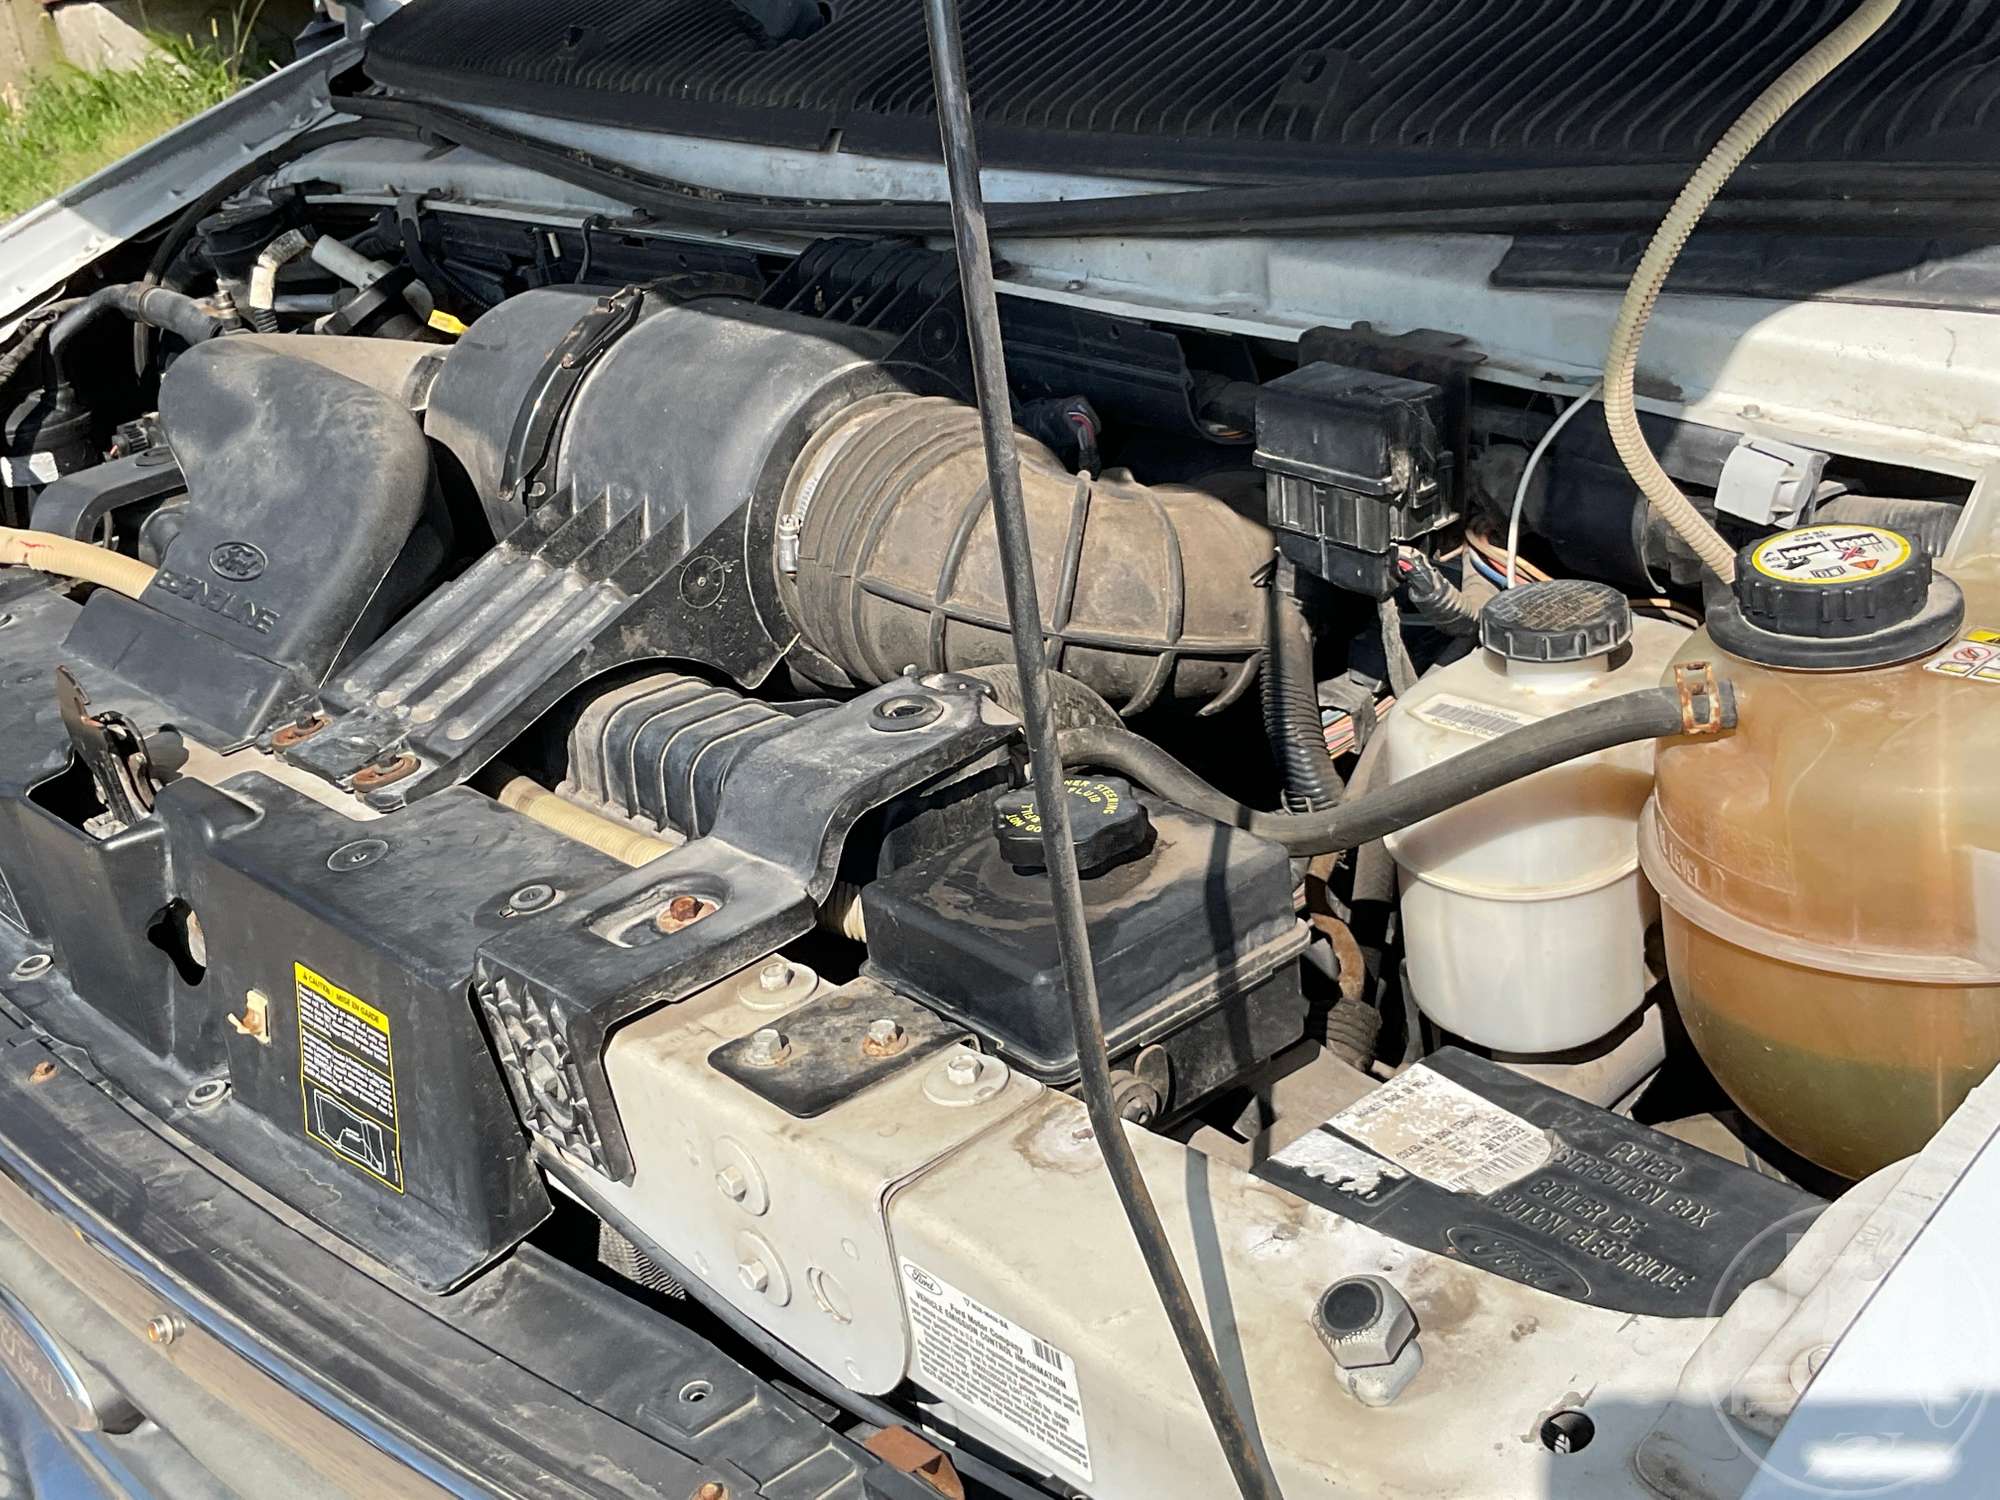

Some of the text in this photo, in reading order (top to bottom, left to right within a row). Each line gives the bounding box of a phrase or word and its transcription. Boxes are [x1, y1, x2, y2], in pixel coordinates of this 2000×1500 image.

[1063, 779, 1119, 815] WER STEERING
[1067, 786, 1102, 803] FLUID
[1005, 814, 1026, 827] NOT
[1668, 842, 1705, 893] LEVEL
[1604, 1140, 1686, 1184] POWER
[1552, 1145, 1718, 1230] STRIBUTION BOX
[1492, 1191, 1571, 1236] BUTION
[1609, 1213, 1650, 1241] DE
[911, 1267, 935, 1293] Ford
[914, 1289, 944, 1315] VEHICLE
[944, 1308, 980, 1338] EMISSION
[979, 1330, 1015, 1360] CONTROL
[1014, 1351, 1067, 1391] INFORMATION
[949, 1302, 966, 1318] Ford
[965, 1312, 989, 1333] Motor
[988, 1325, 1025, 1355] Company
